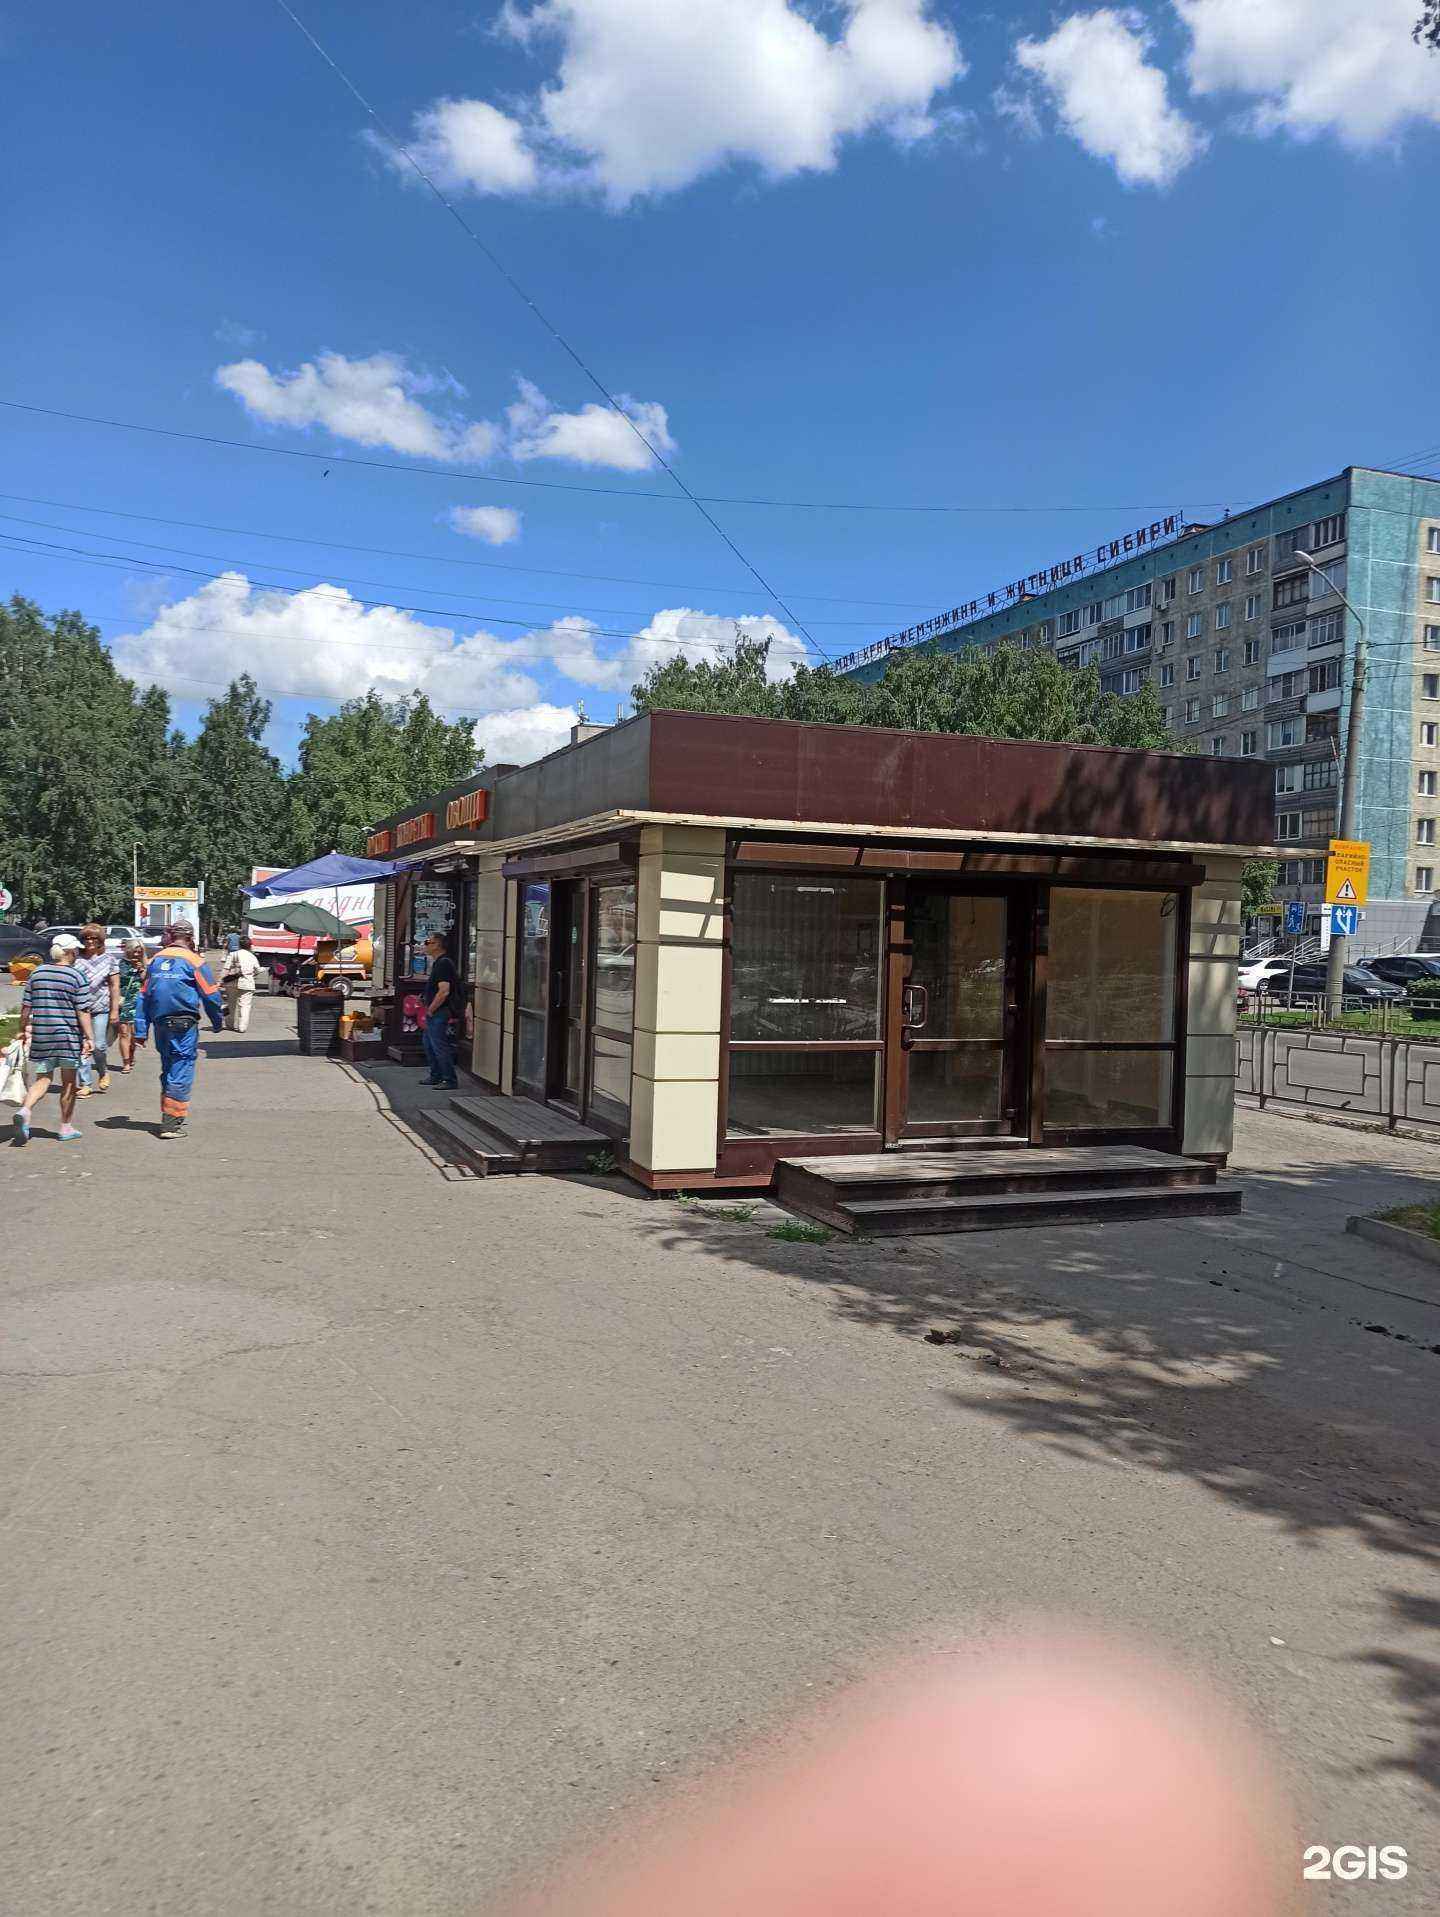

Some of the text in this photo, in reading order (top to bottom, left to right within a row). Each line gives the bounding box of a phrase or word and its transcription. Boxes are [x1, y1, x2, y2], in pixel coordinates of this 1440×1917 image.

[900, 601, 977, 643] ЖЕМЧУЖИНА
[987, 591, 996, 608] И
[1006, 555, 1083, 598] ЖИТНИЦА
[1097, 515, 1175, 563] СИБИРИ
